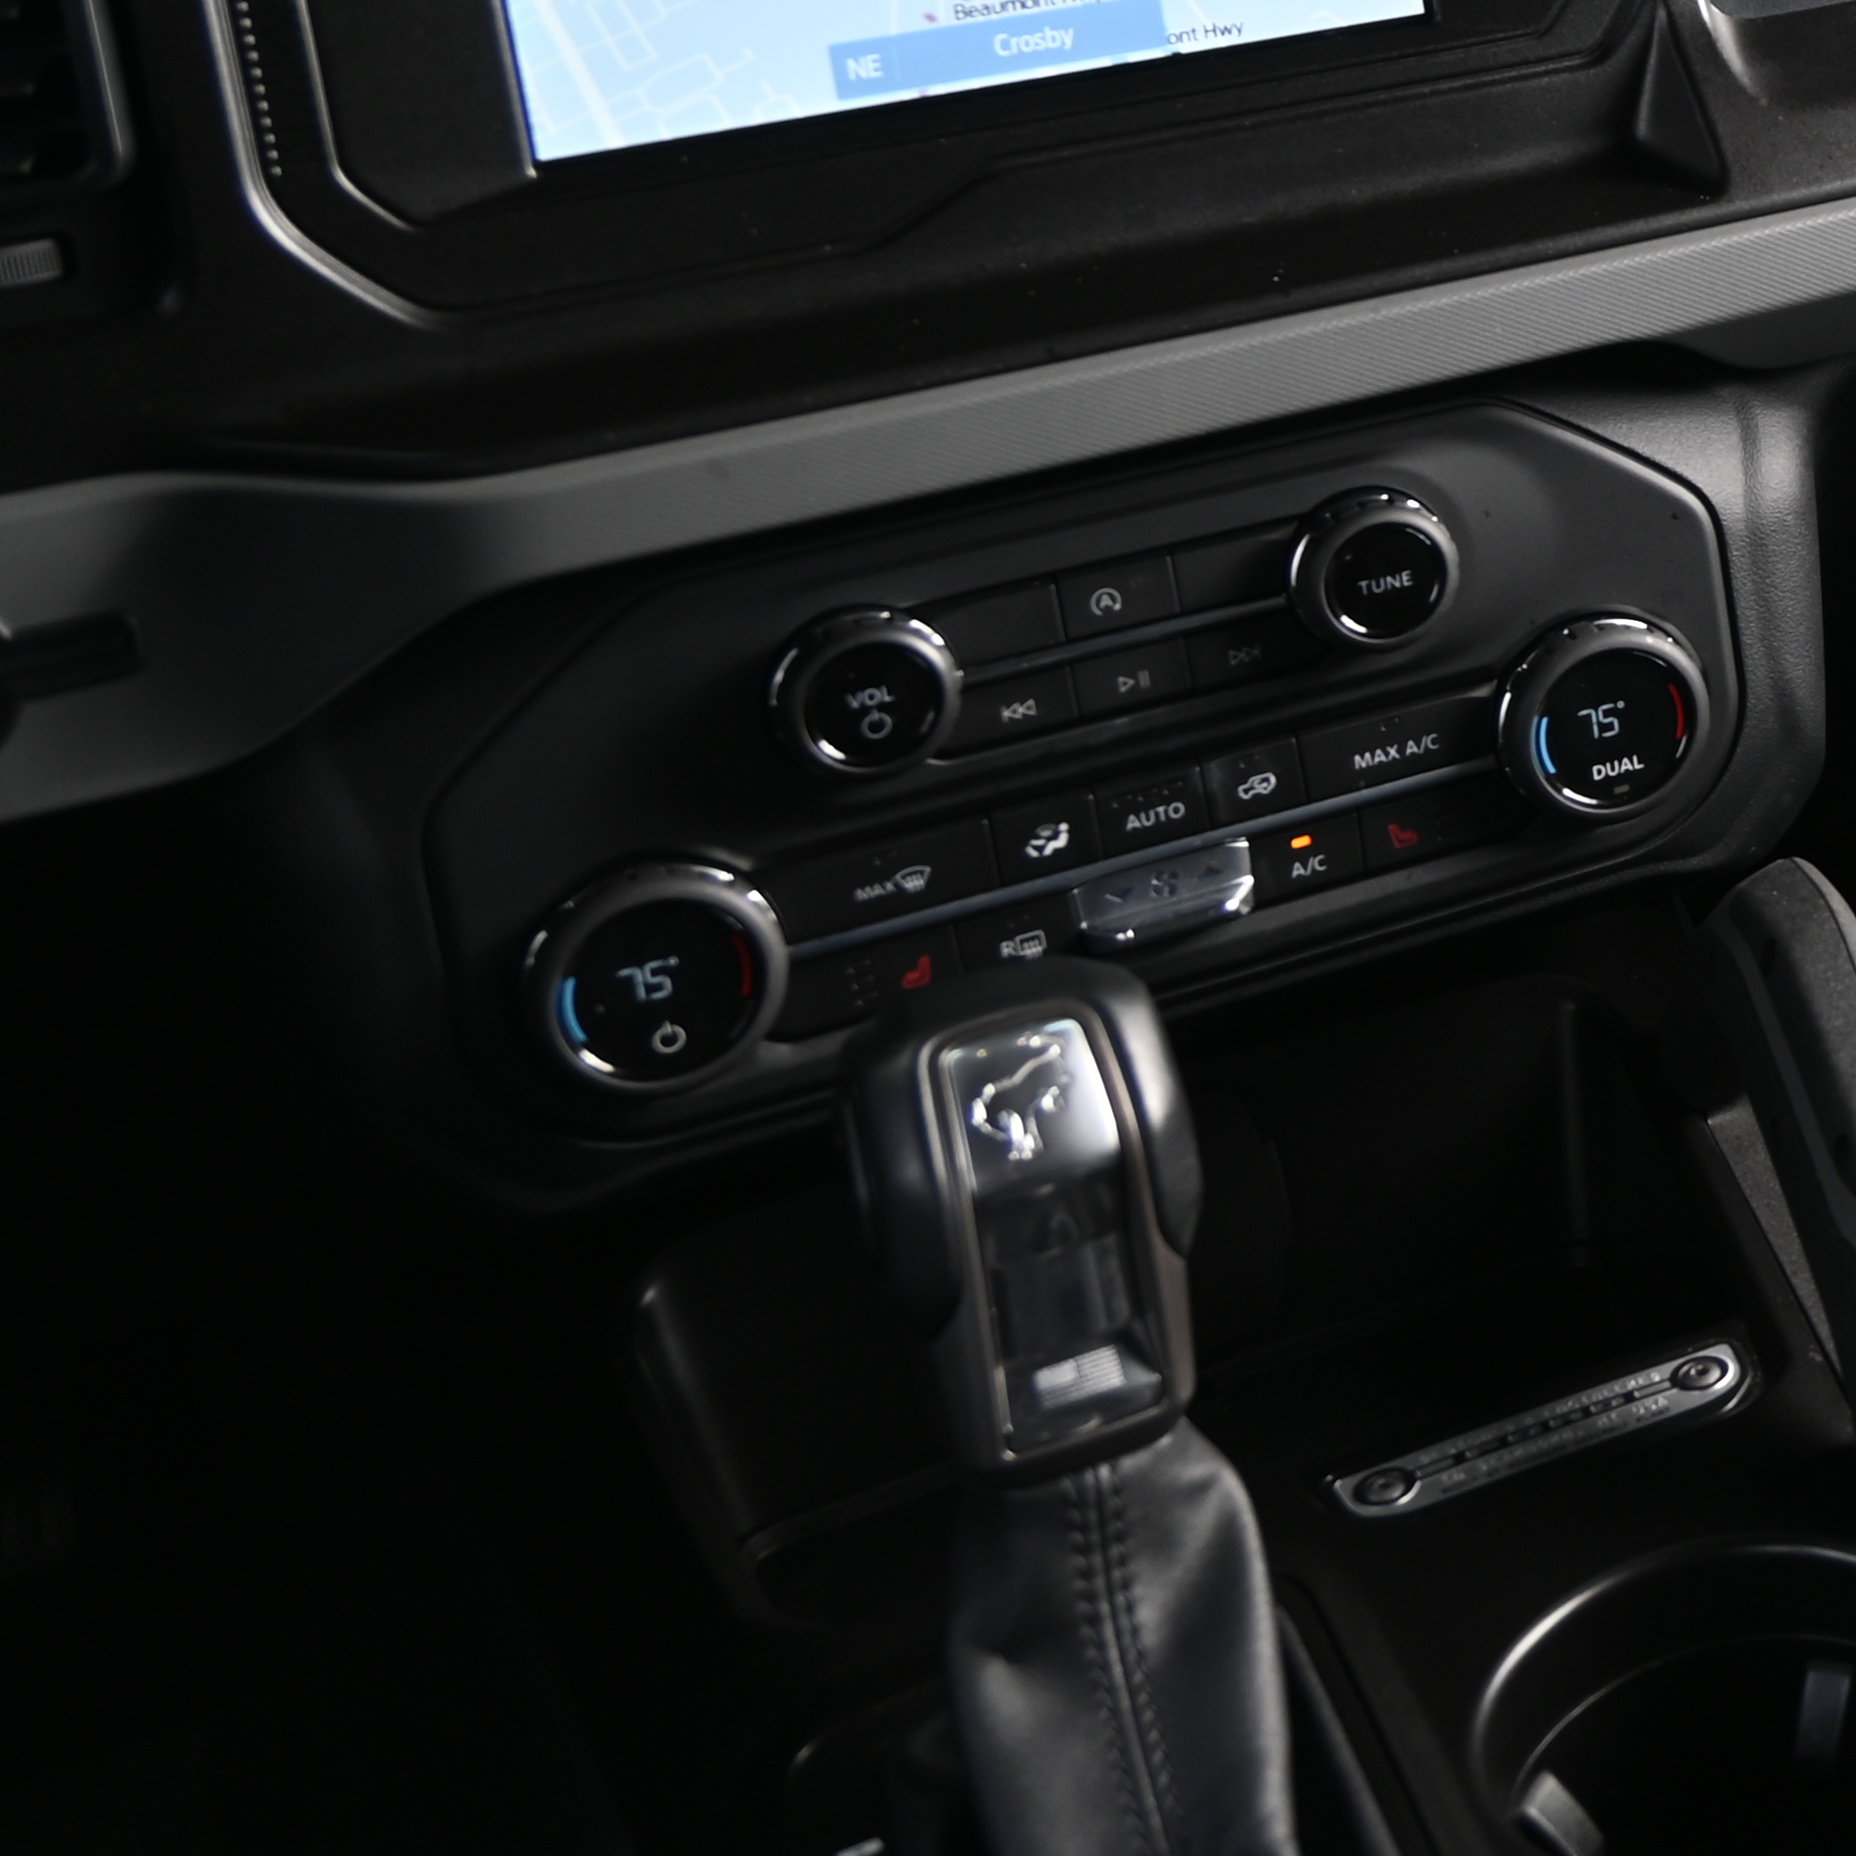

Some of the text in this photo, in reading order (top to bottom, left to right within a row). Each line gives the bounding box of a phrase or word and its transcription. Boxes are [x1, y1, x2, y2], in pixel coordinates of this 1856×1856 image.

[993, 25, 1075, 58] Crosby
[1204, 20, 1244, 40] Hwy
[846, 53, 884, 81] NE
[1357, 569, 1414, 596] TUNE
[845, 685, 896, 710] VOL
[1577, 700, 1626, 741] 75°
[1353, 733, 1440, 770] MAX A/C
[1592, 754, 1646, 782] DUAL
[1126, 801, 1186, 831] AUTO
[1291, 854, 1328, 879] A/C
[854, 879, 897, 903] MAX
[616, 955, 681, 1003] 75°
